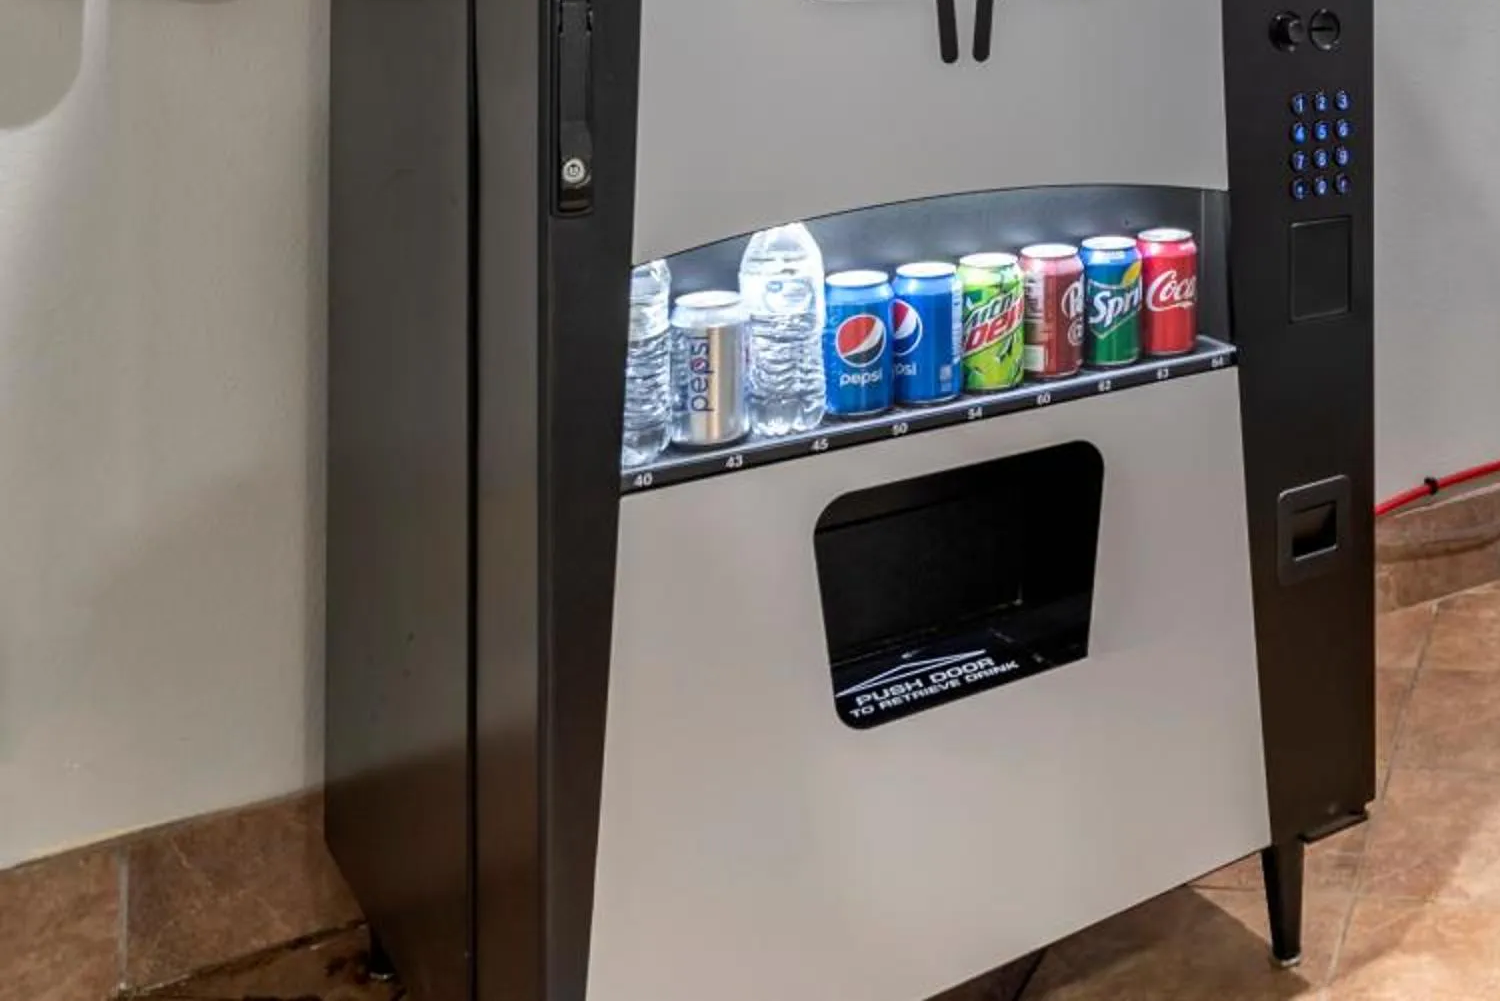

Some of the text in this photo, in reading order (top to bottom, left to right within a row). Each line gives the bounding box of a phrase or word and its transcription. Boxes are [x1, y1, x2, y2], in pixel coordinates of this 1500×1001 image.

[691, 336, 714, 412] pepsi
[839, 368, 882, 388] pepsi
[812, 439, 829, 452] 45
[726, 454, 743, 468] 43
[634, 473, 653, 487] 40
[849, 660, 1020, 719] TO RETRIEVE DRINK
[855, 656, 996, 706] PUSH DOOR
